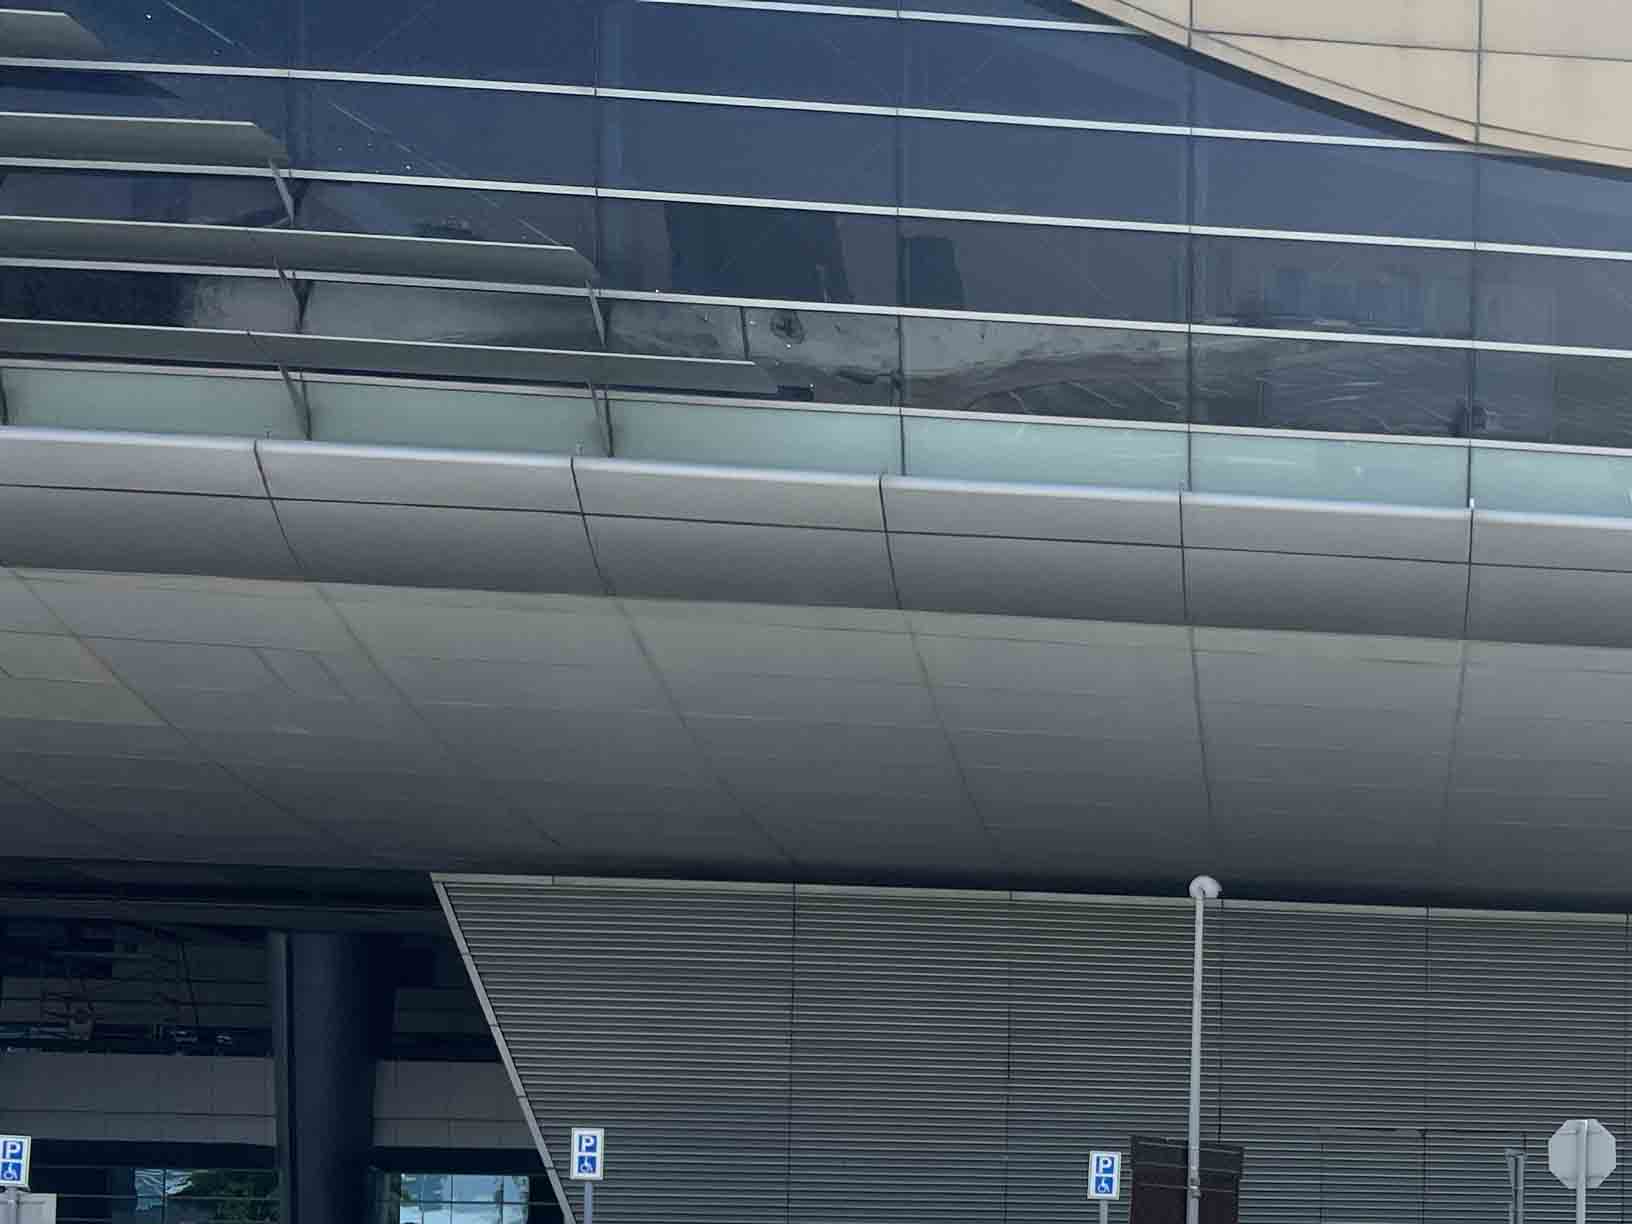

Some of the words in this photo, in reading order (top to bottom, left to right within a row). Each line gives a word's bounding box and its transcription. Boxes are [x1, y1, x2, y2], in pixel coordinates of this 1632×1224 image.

[6, 1141, 21, 1159] P
[582, 1136, 594, 1152] P
[1099, 1157, 1112, 1173] P
